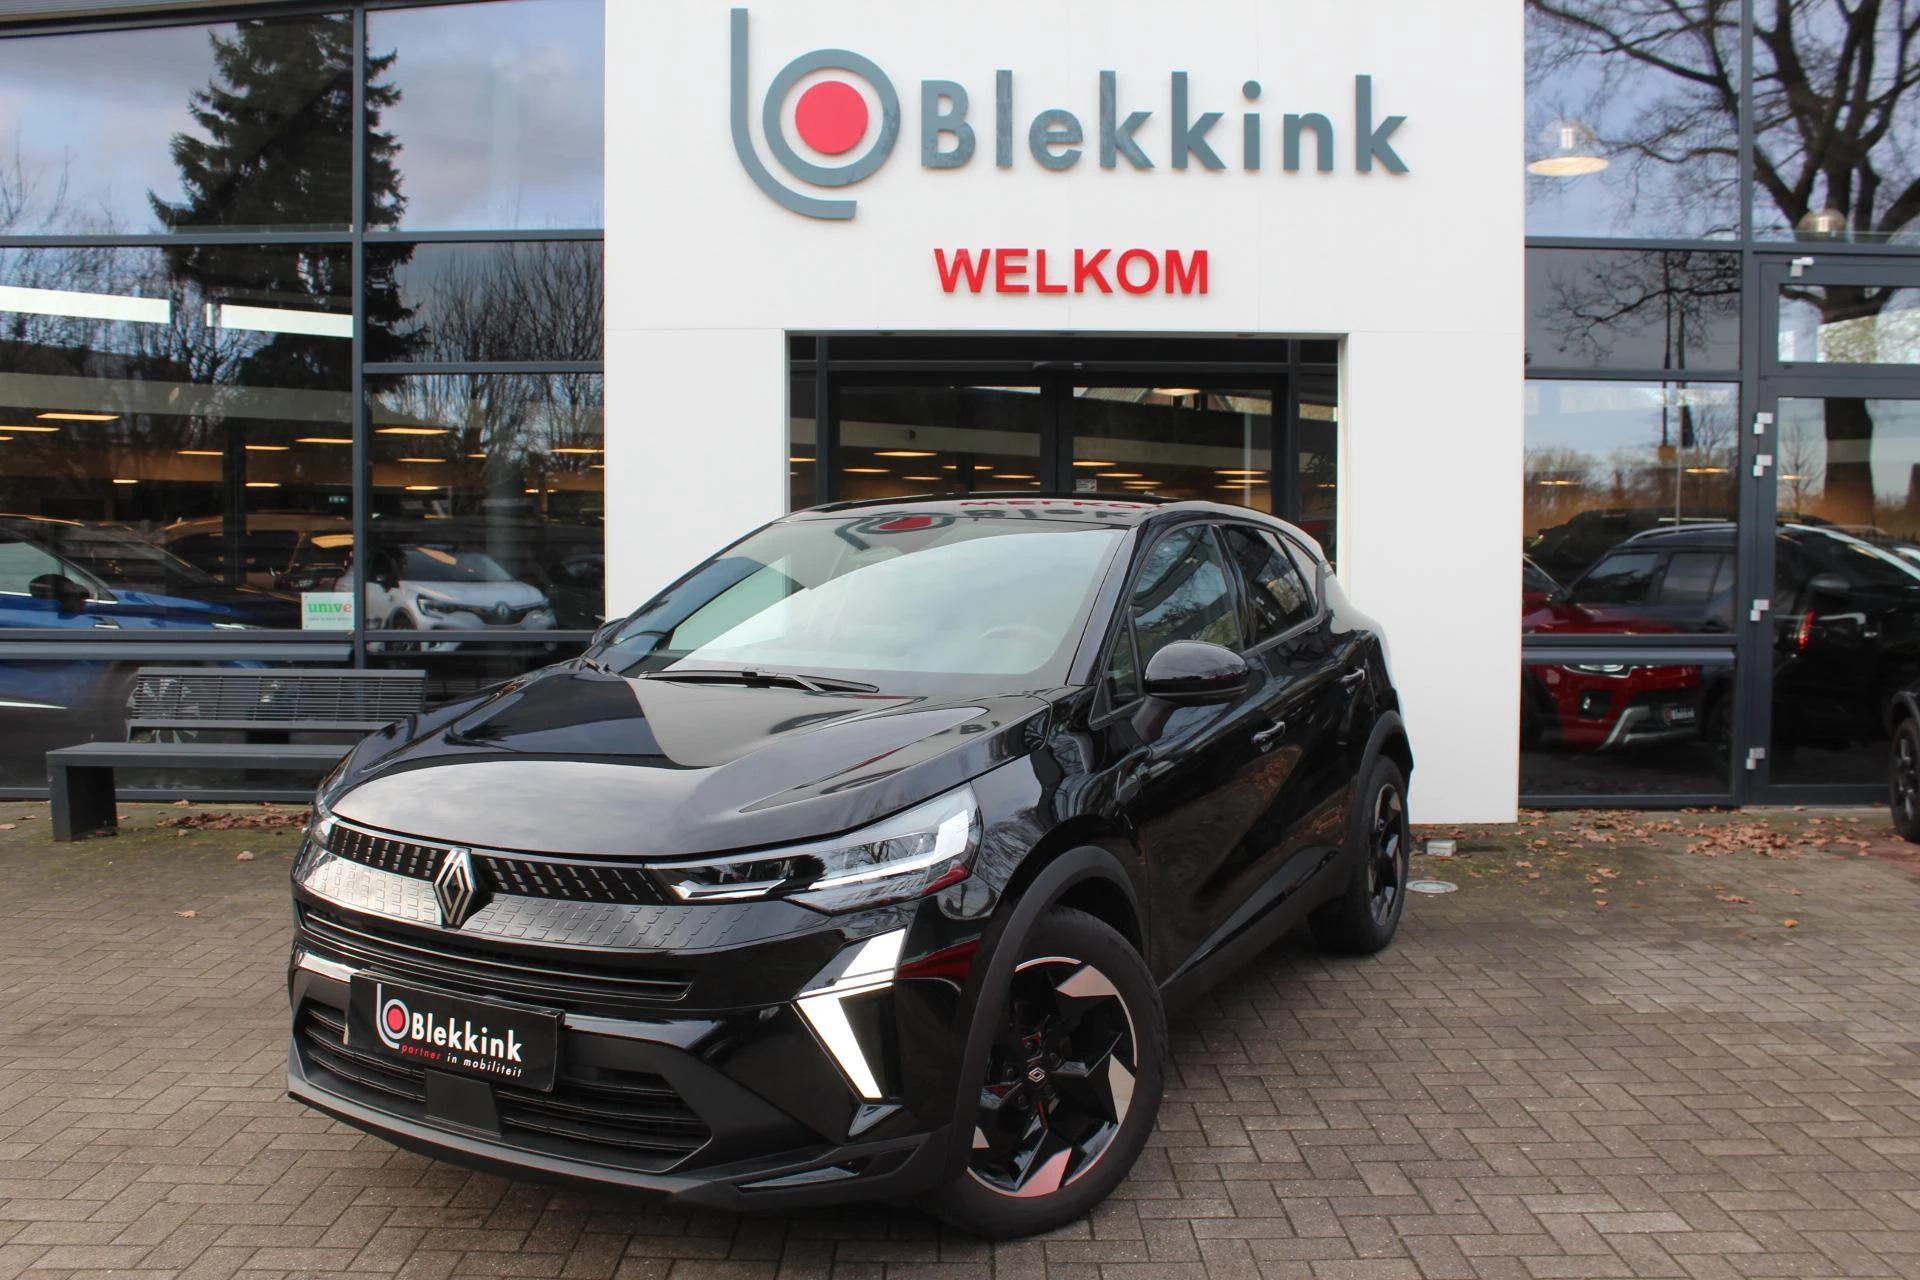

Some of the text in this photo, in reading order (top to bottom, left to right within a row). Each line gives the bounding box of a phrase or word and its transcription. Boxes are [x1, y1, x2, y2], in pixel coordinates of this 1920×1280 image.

[920, 69, 1410, 173] Blekkink
[933, 247, 1209, 295] WELKOM
[401, 1044, 522, 1078] partner in mobiliteit
[411, 1012, 522, 1063] Blekkink
